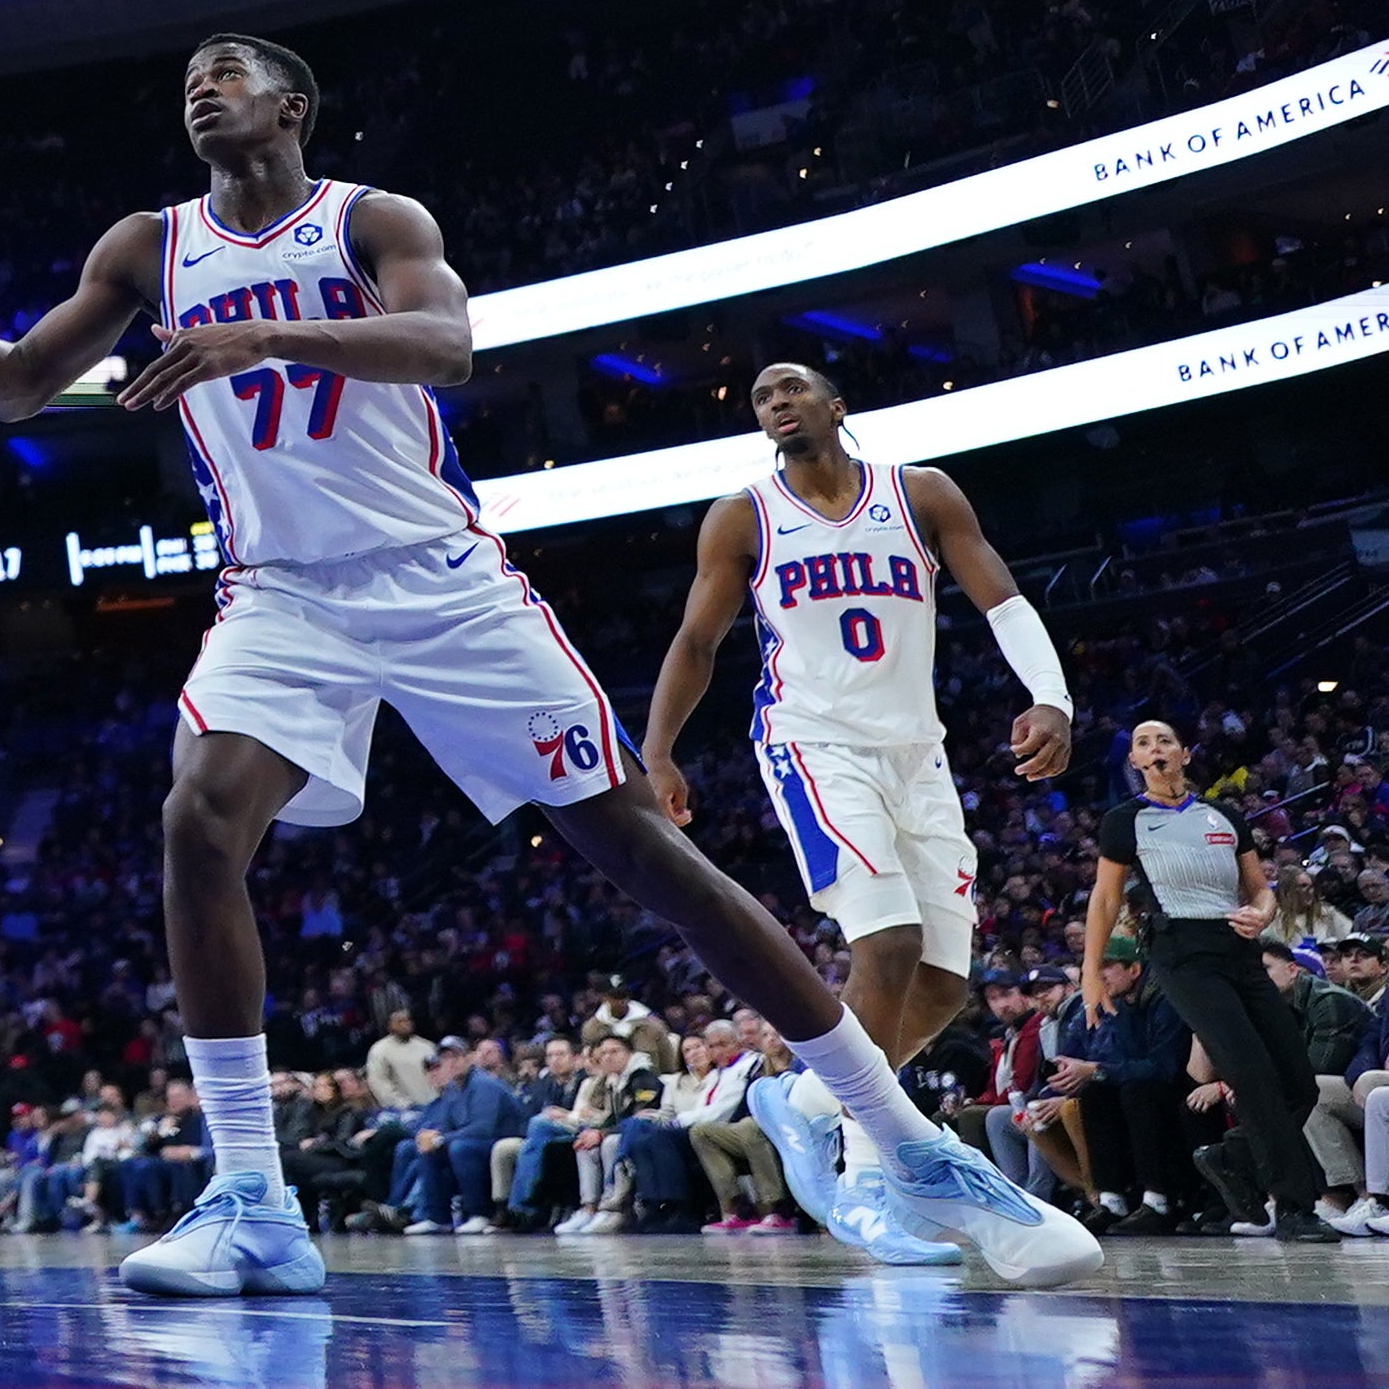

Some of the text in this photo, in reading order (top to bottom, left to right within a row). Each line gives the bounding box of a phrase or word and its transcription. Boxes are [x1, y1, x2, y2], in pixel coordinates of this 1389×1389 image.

[1094, 78, 1366, 181] BANK OF AMERICA
[282, 243, 337, 260] crypto.com
[1177, 347, 1260, 382] BANK
[1270, 335, 1305, 360] OF
[230, 363, 345, 451] 77
[6, 548, 20, 577] 7
[775, 552, 923, 611] PHILA
[839, 607, 885, 662] 0
[532, 724, 599, 782] 76
